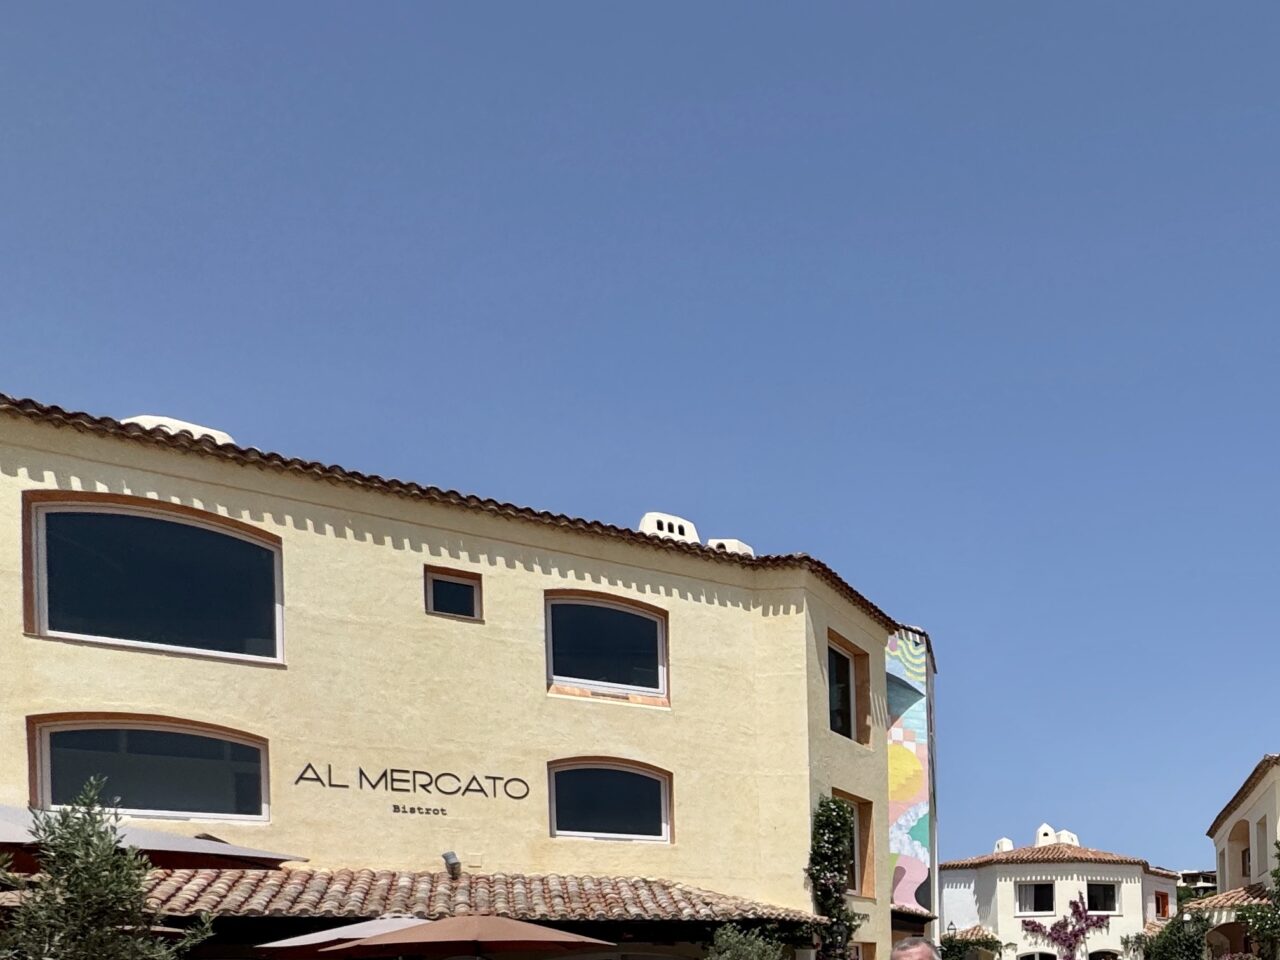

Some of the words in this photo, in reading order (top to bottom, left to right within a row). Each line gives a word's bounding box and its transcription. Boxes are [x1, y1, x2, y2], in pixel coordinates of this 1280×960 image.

[294, 762, 349, 789] AL
[358, 766, 530, 800] MERCATO
[392, 804, 448, 816] Bistrot
